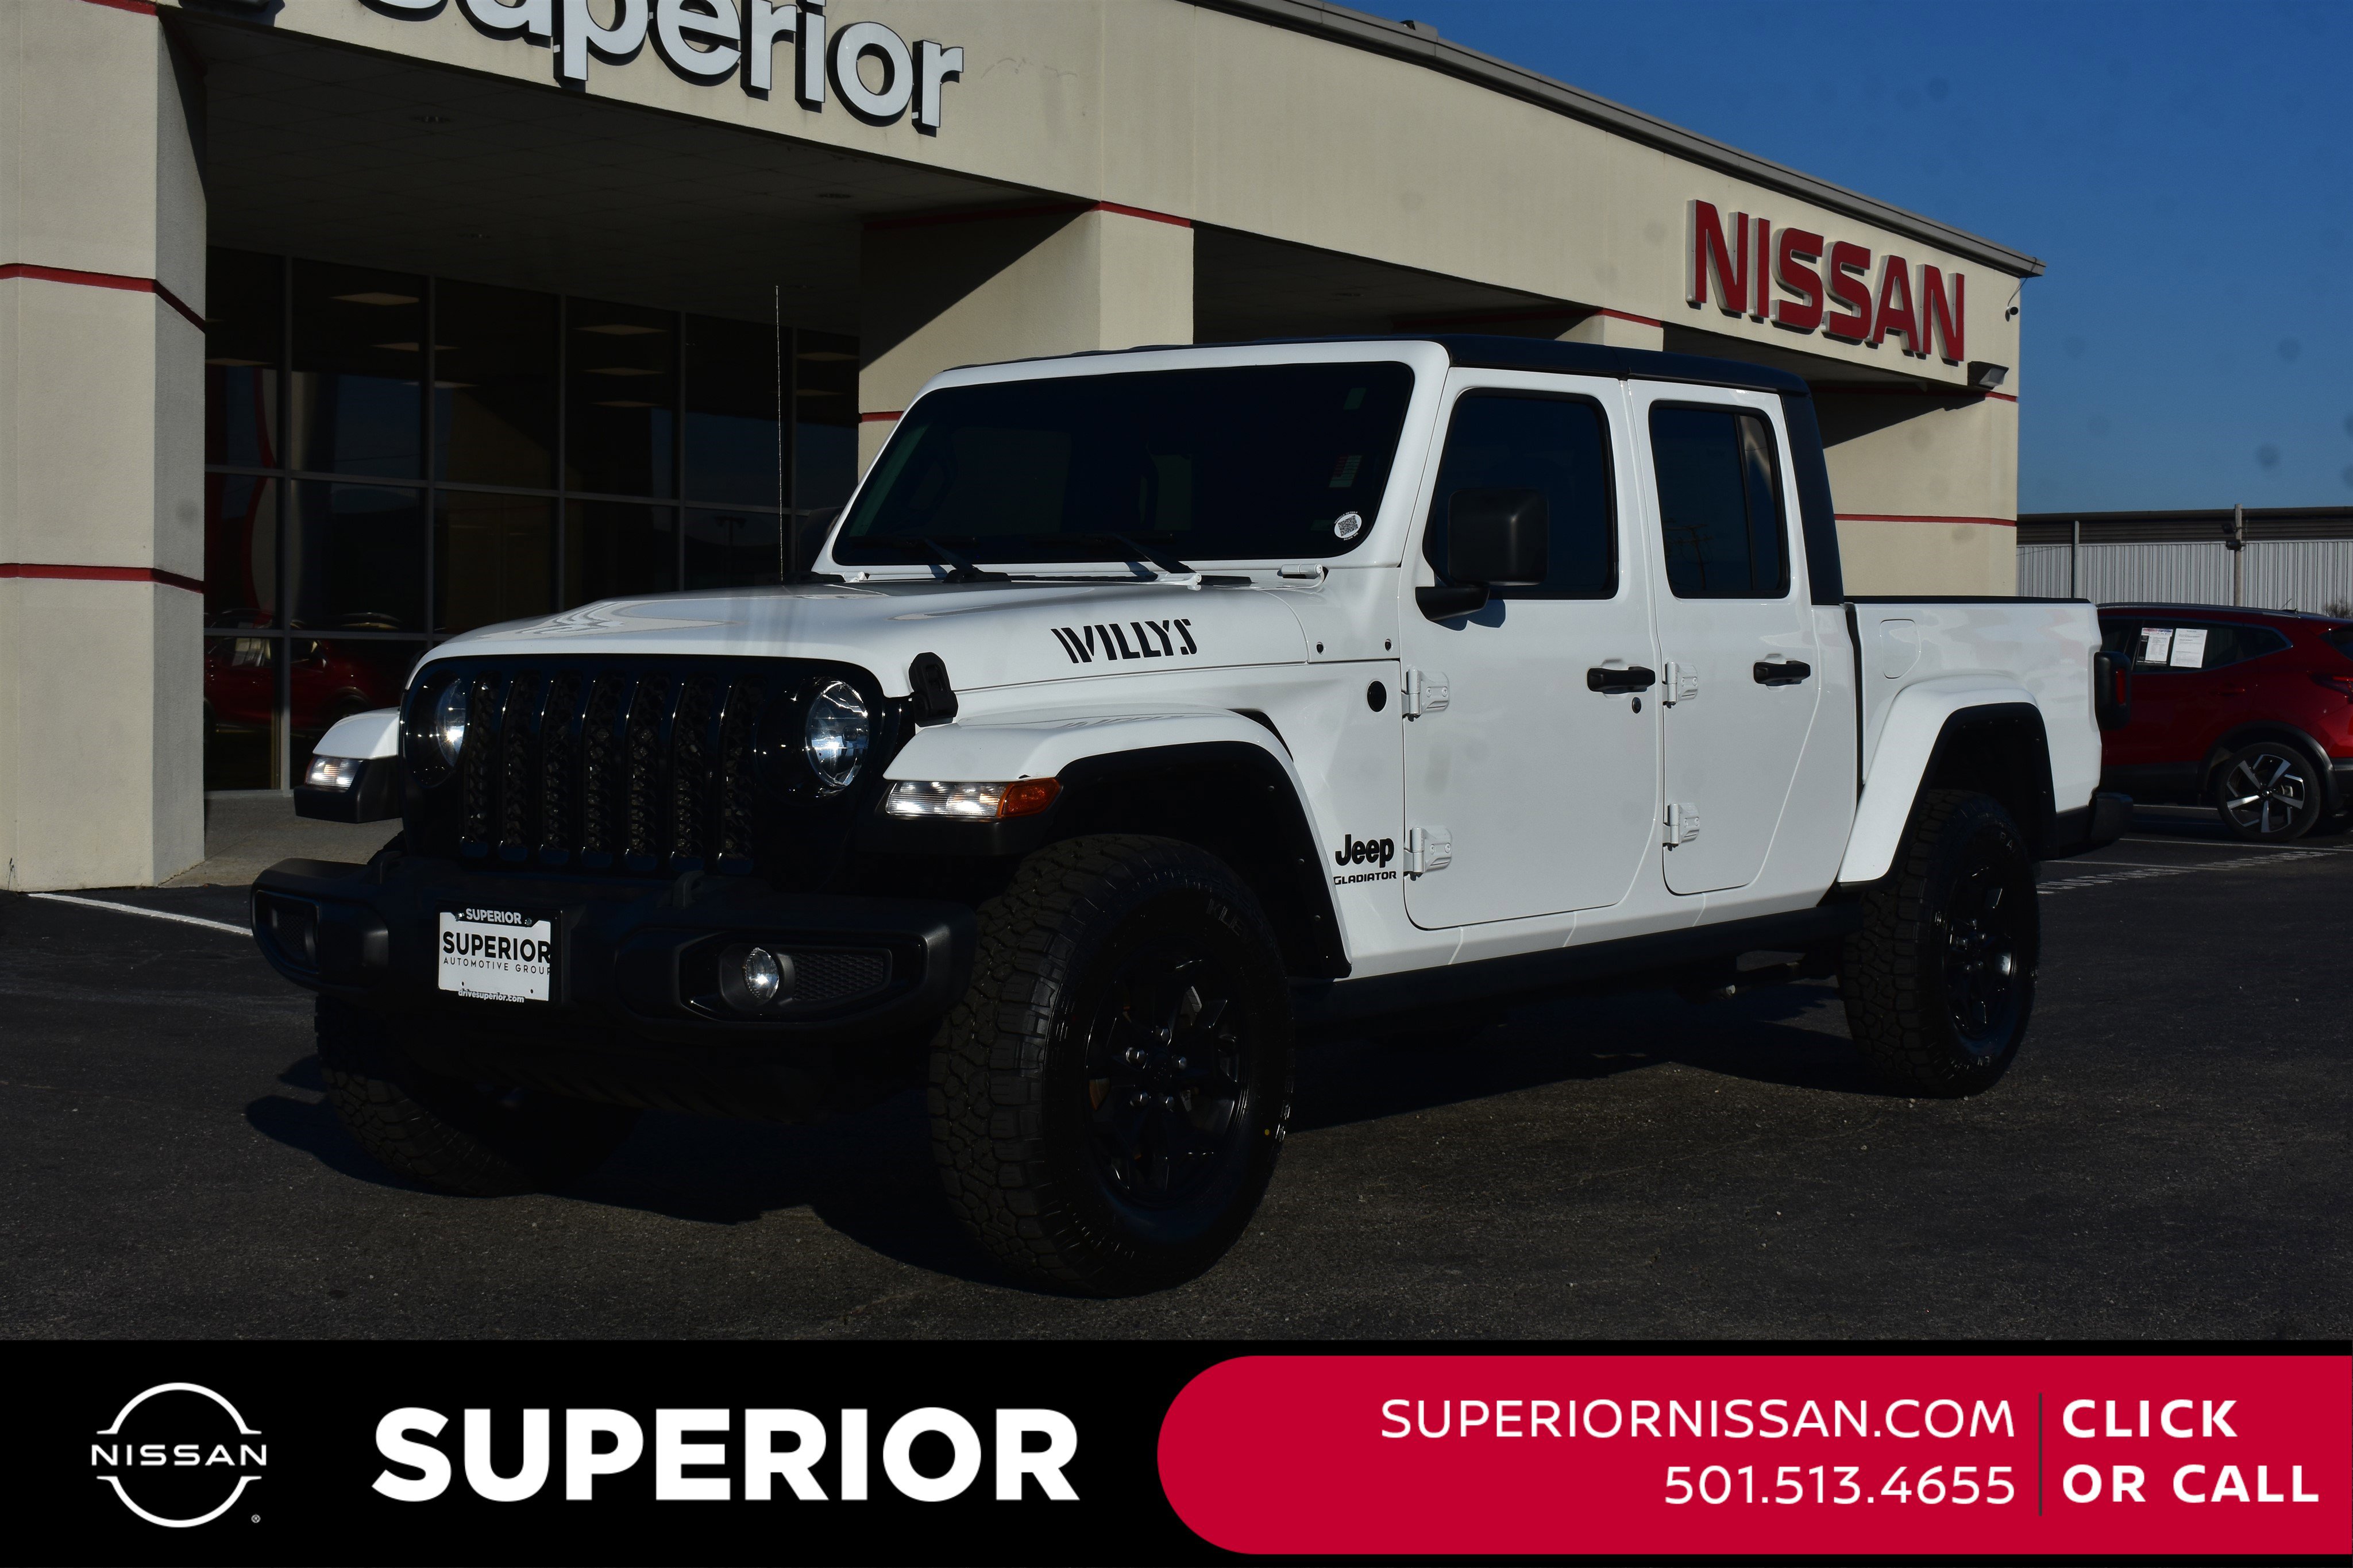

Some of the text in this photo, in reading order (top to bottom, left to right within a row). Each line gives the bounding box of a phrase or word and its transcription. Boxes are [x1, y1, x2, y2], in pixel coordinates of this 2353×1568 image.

[368, 0, 964, 128] perior
[1685, 199, 1965, 362] NISSAN
[1050, 619, 1197, 663] WILLYS
[1335, 834, 1394, 868] Jeep
[1333, 871, 1397, 885] GLADIATOR
[466, 908, 522, 924] SUPERIOR
[443, 931, 551, 964] SUPERIOR
[443, 957, 508, 971] AUTOMOTIVE
[458, 988, 524, 1003] drivesuperior.com
